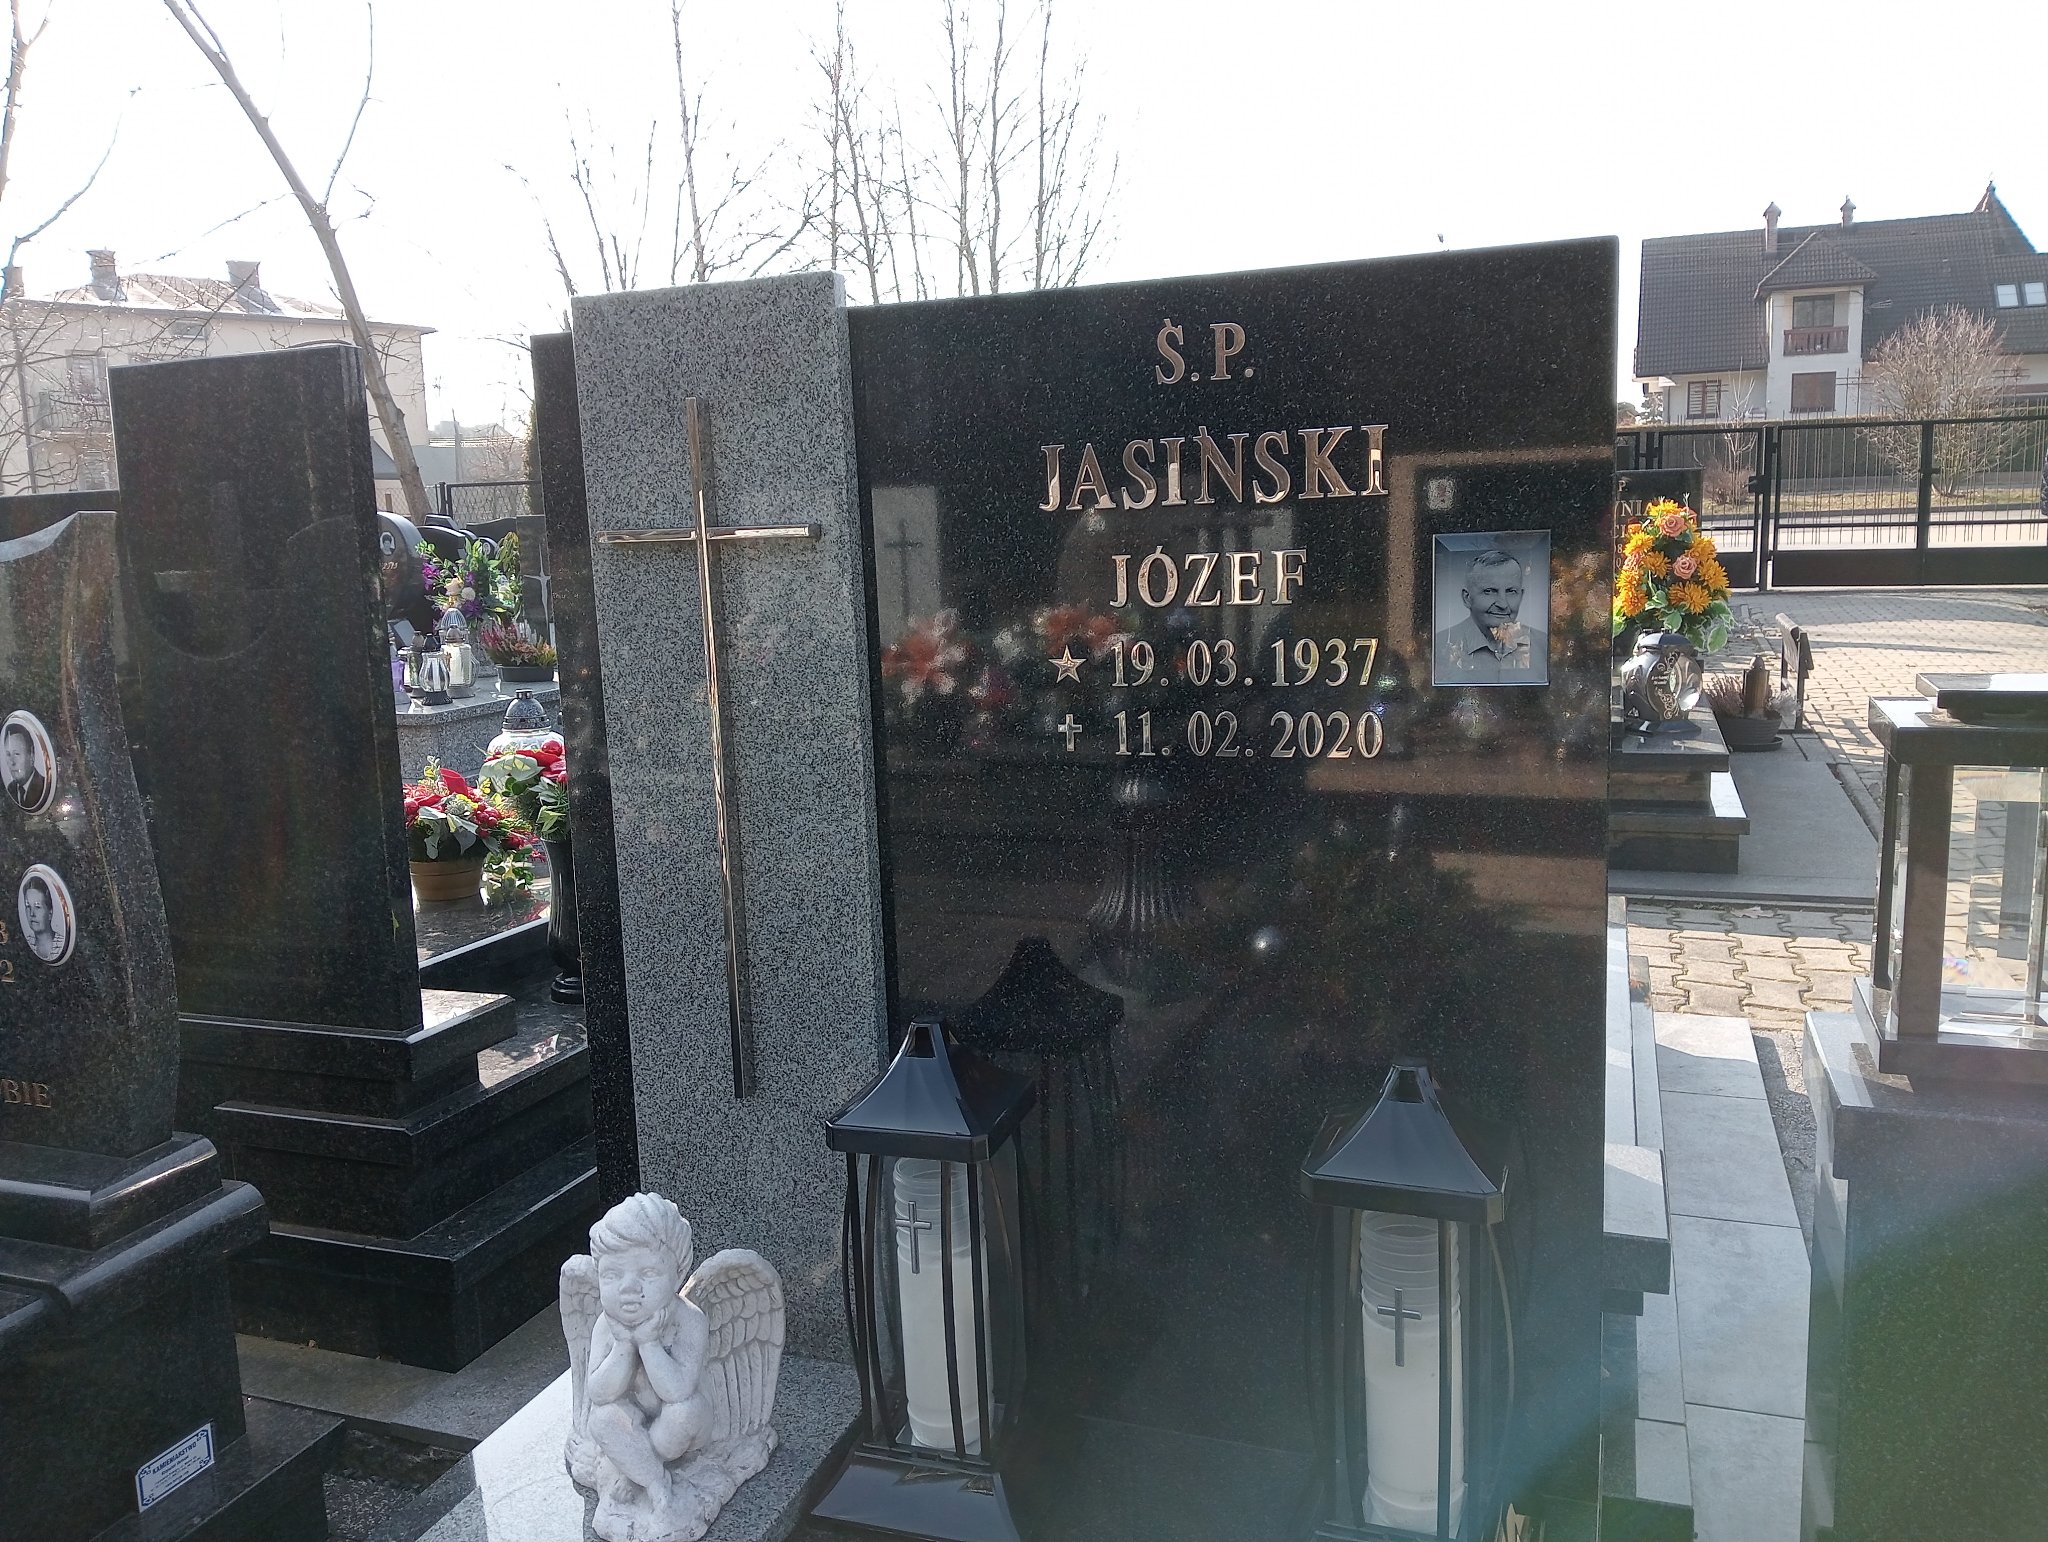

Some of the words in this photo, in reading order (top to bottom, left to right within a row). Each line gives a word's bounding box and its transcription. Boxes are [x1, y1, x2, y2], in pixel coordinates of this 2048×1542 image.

[1110, 545, 1307, 608] JÓZEF
[1271, 637, 1379, 687] 1937
[1270, 710, 1384, 758] 2020
